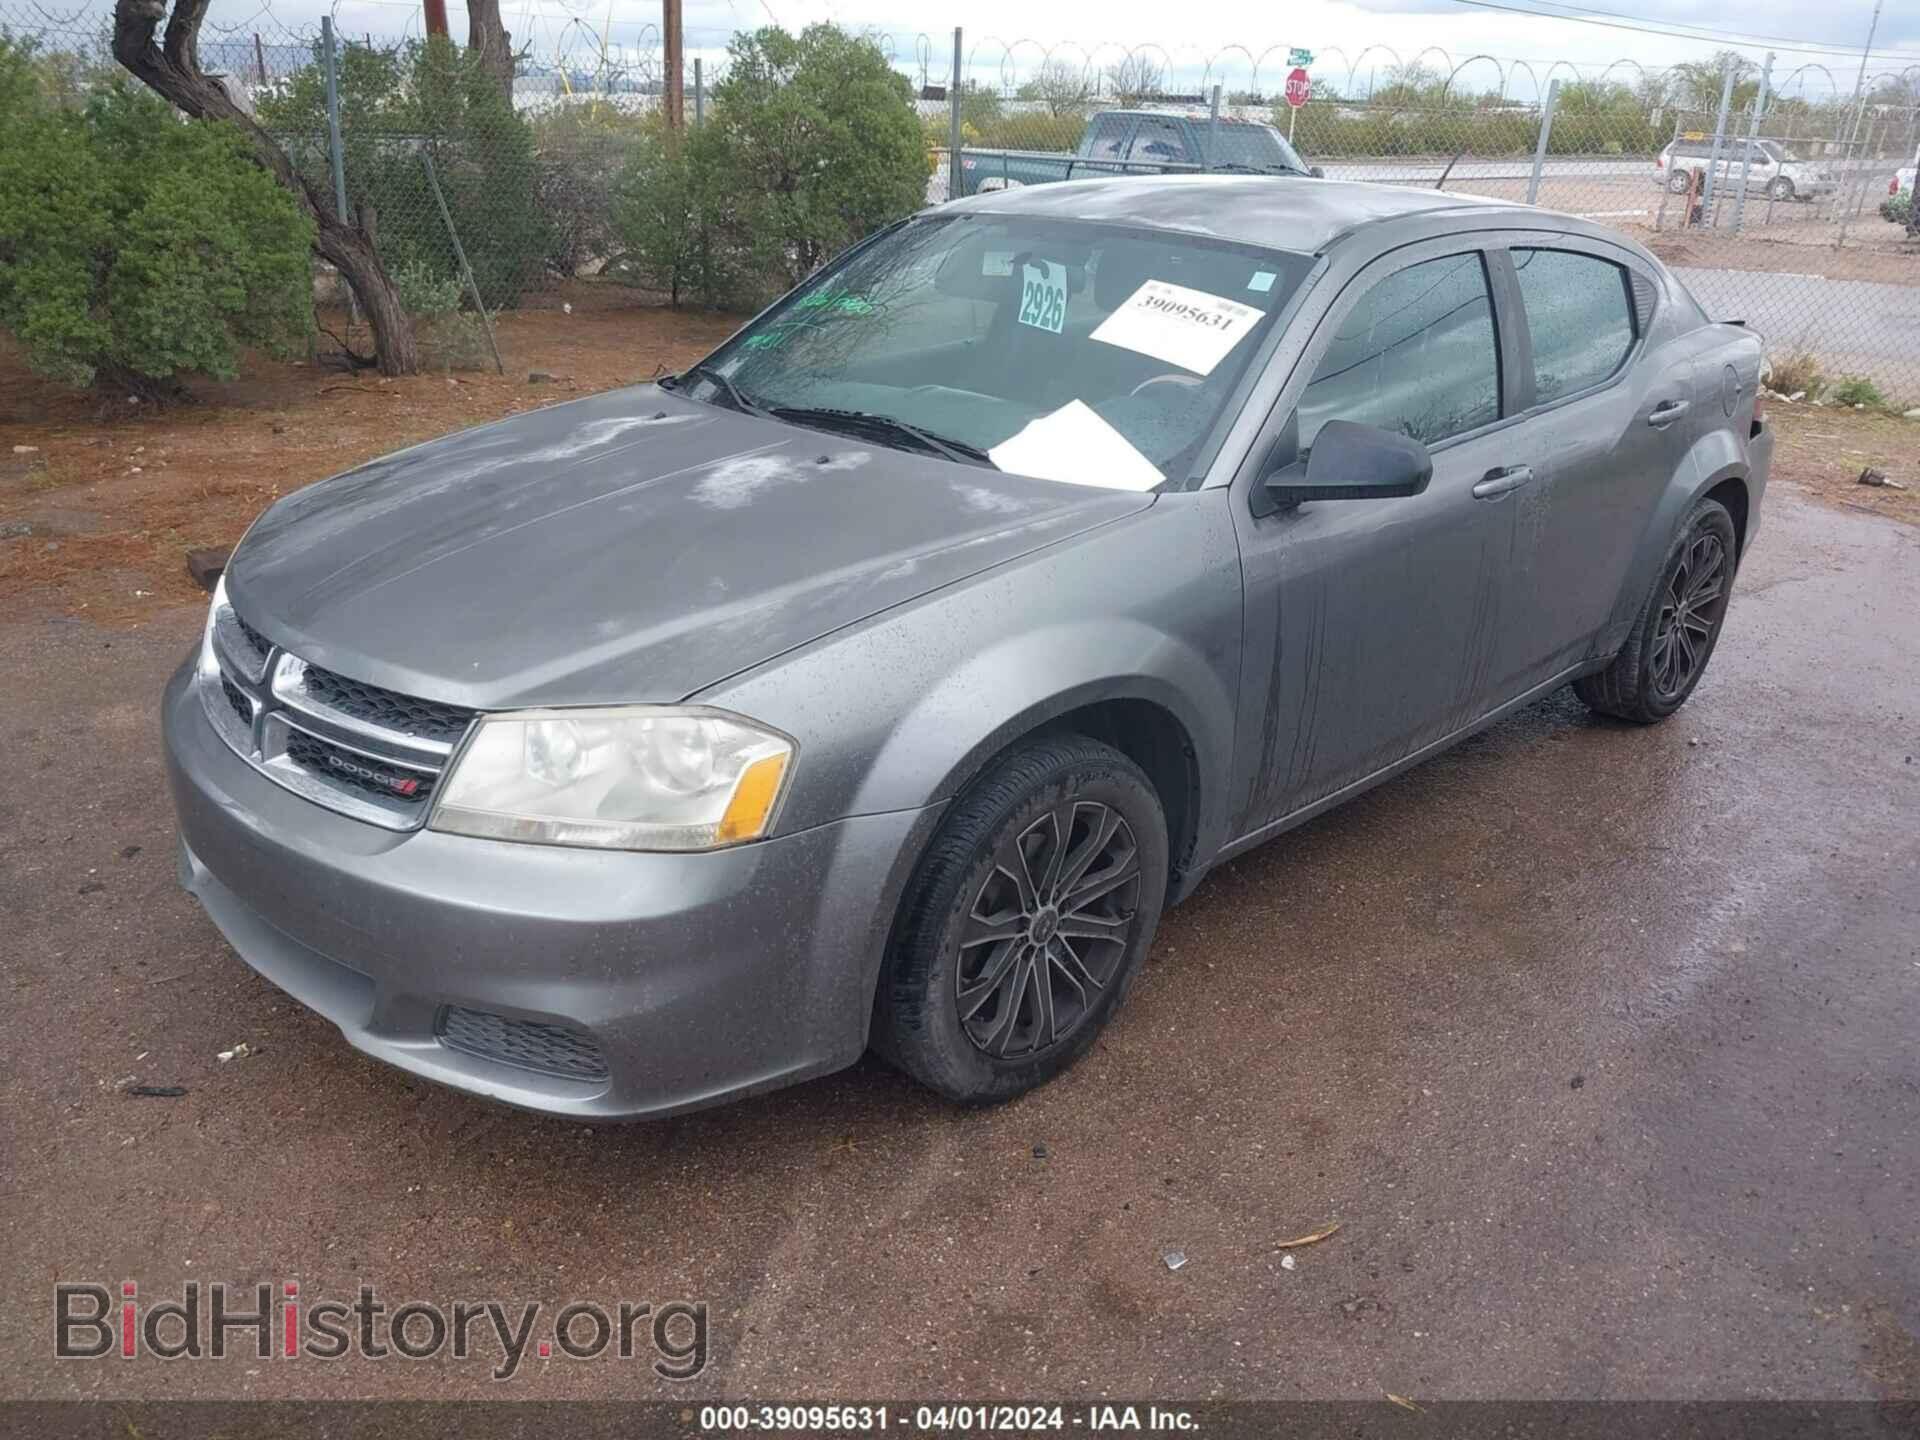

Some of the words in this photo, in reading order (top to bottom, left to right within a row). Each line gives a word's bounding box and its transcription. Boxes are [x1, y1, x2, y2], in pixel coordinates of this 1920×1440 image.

[1287, 80, 1310, 98] STOP
[1023, 280, 1064, 331] 2926
[1137, 295, 1233, 331] 39095631
[329, 755, 402, 790] DODGE
